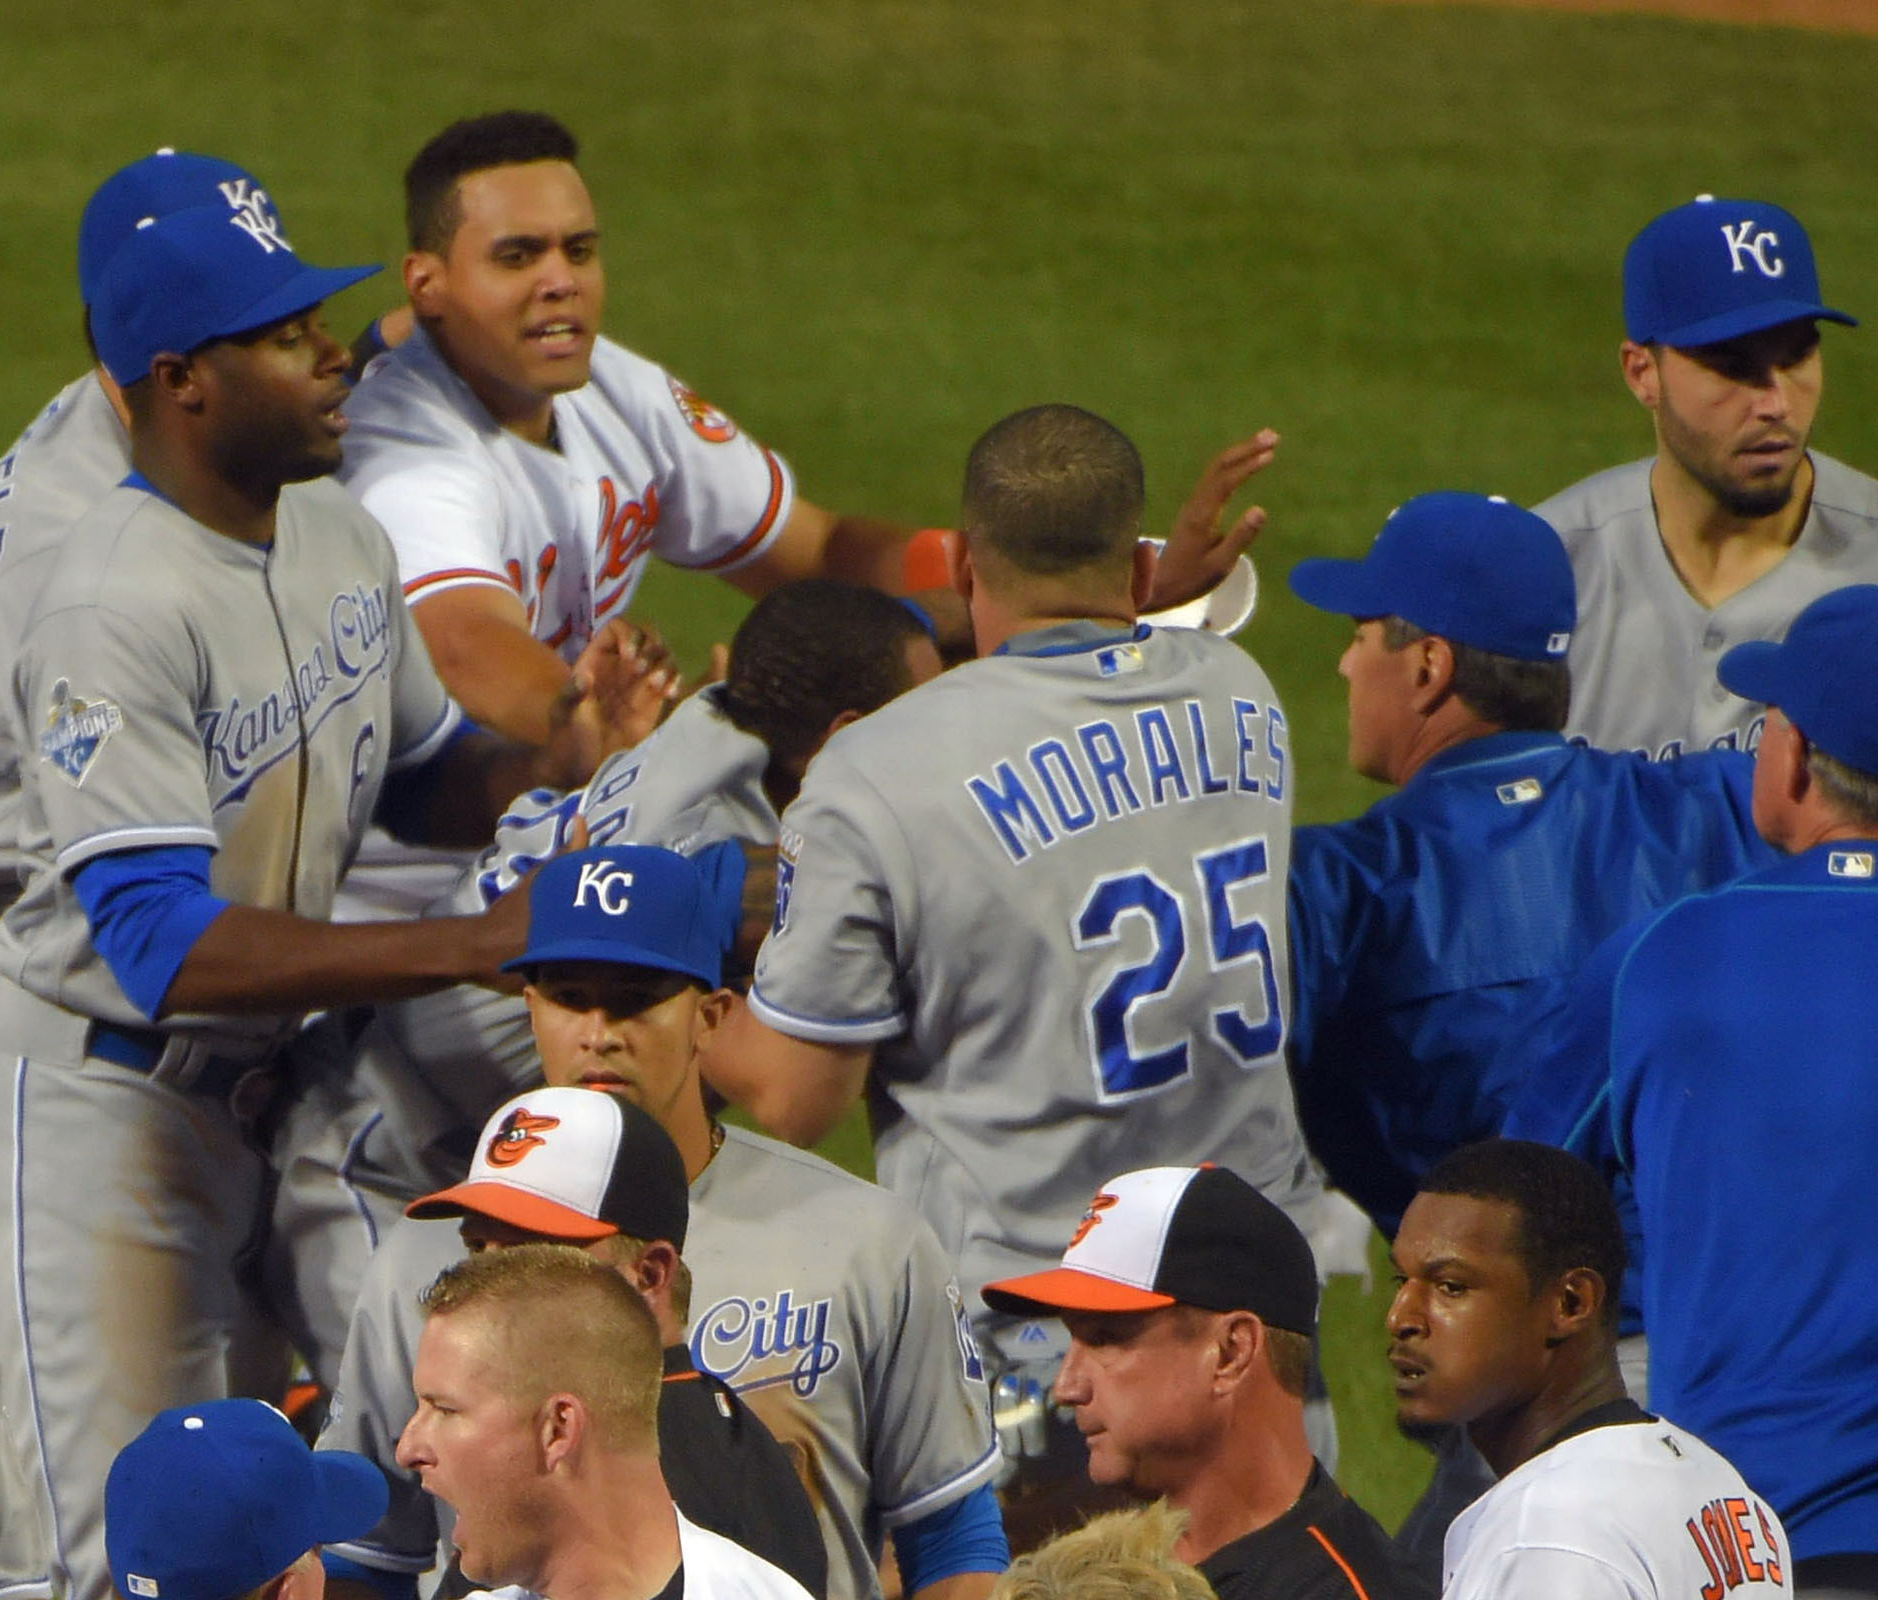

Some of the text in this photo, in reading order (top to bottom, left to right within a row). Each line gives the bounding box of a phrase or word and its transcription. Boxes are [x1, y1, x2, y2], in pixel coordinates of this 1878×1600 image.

[1721, 220, 1782, 278] KC
[195, 645, 334, 784] Kansas
[965, 696, 1289, 867] MORALES
[572, 859, 634, 917] KC
[1070, 832, 1288, 1105] 25
[689, 1289, 841, 1400] City
